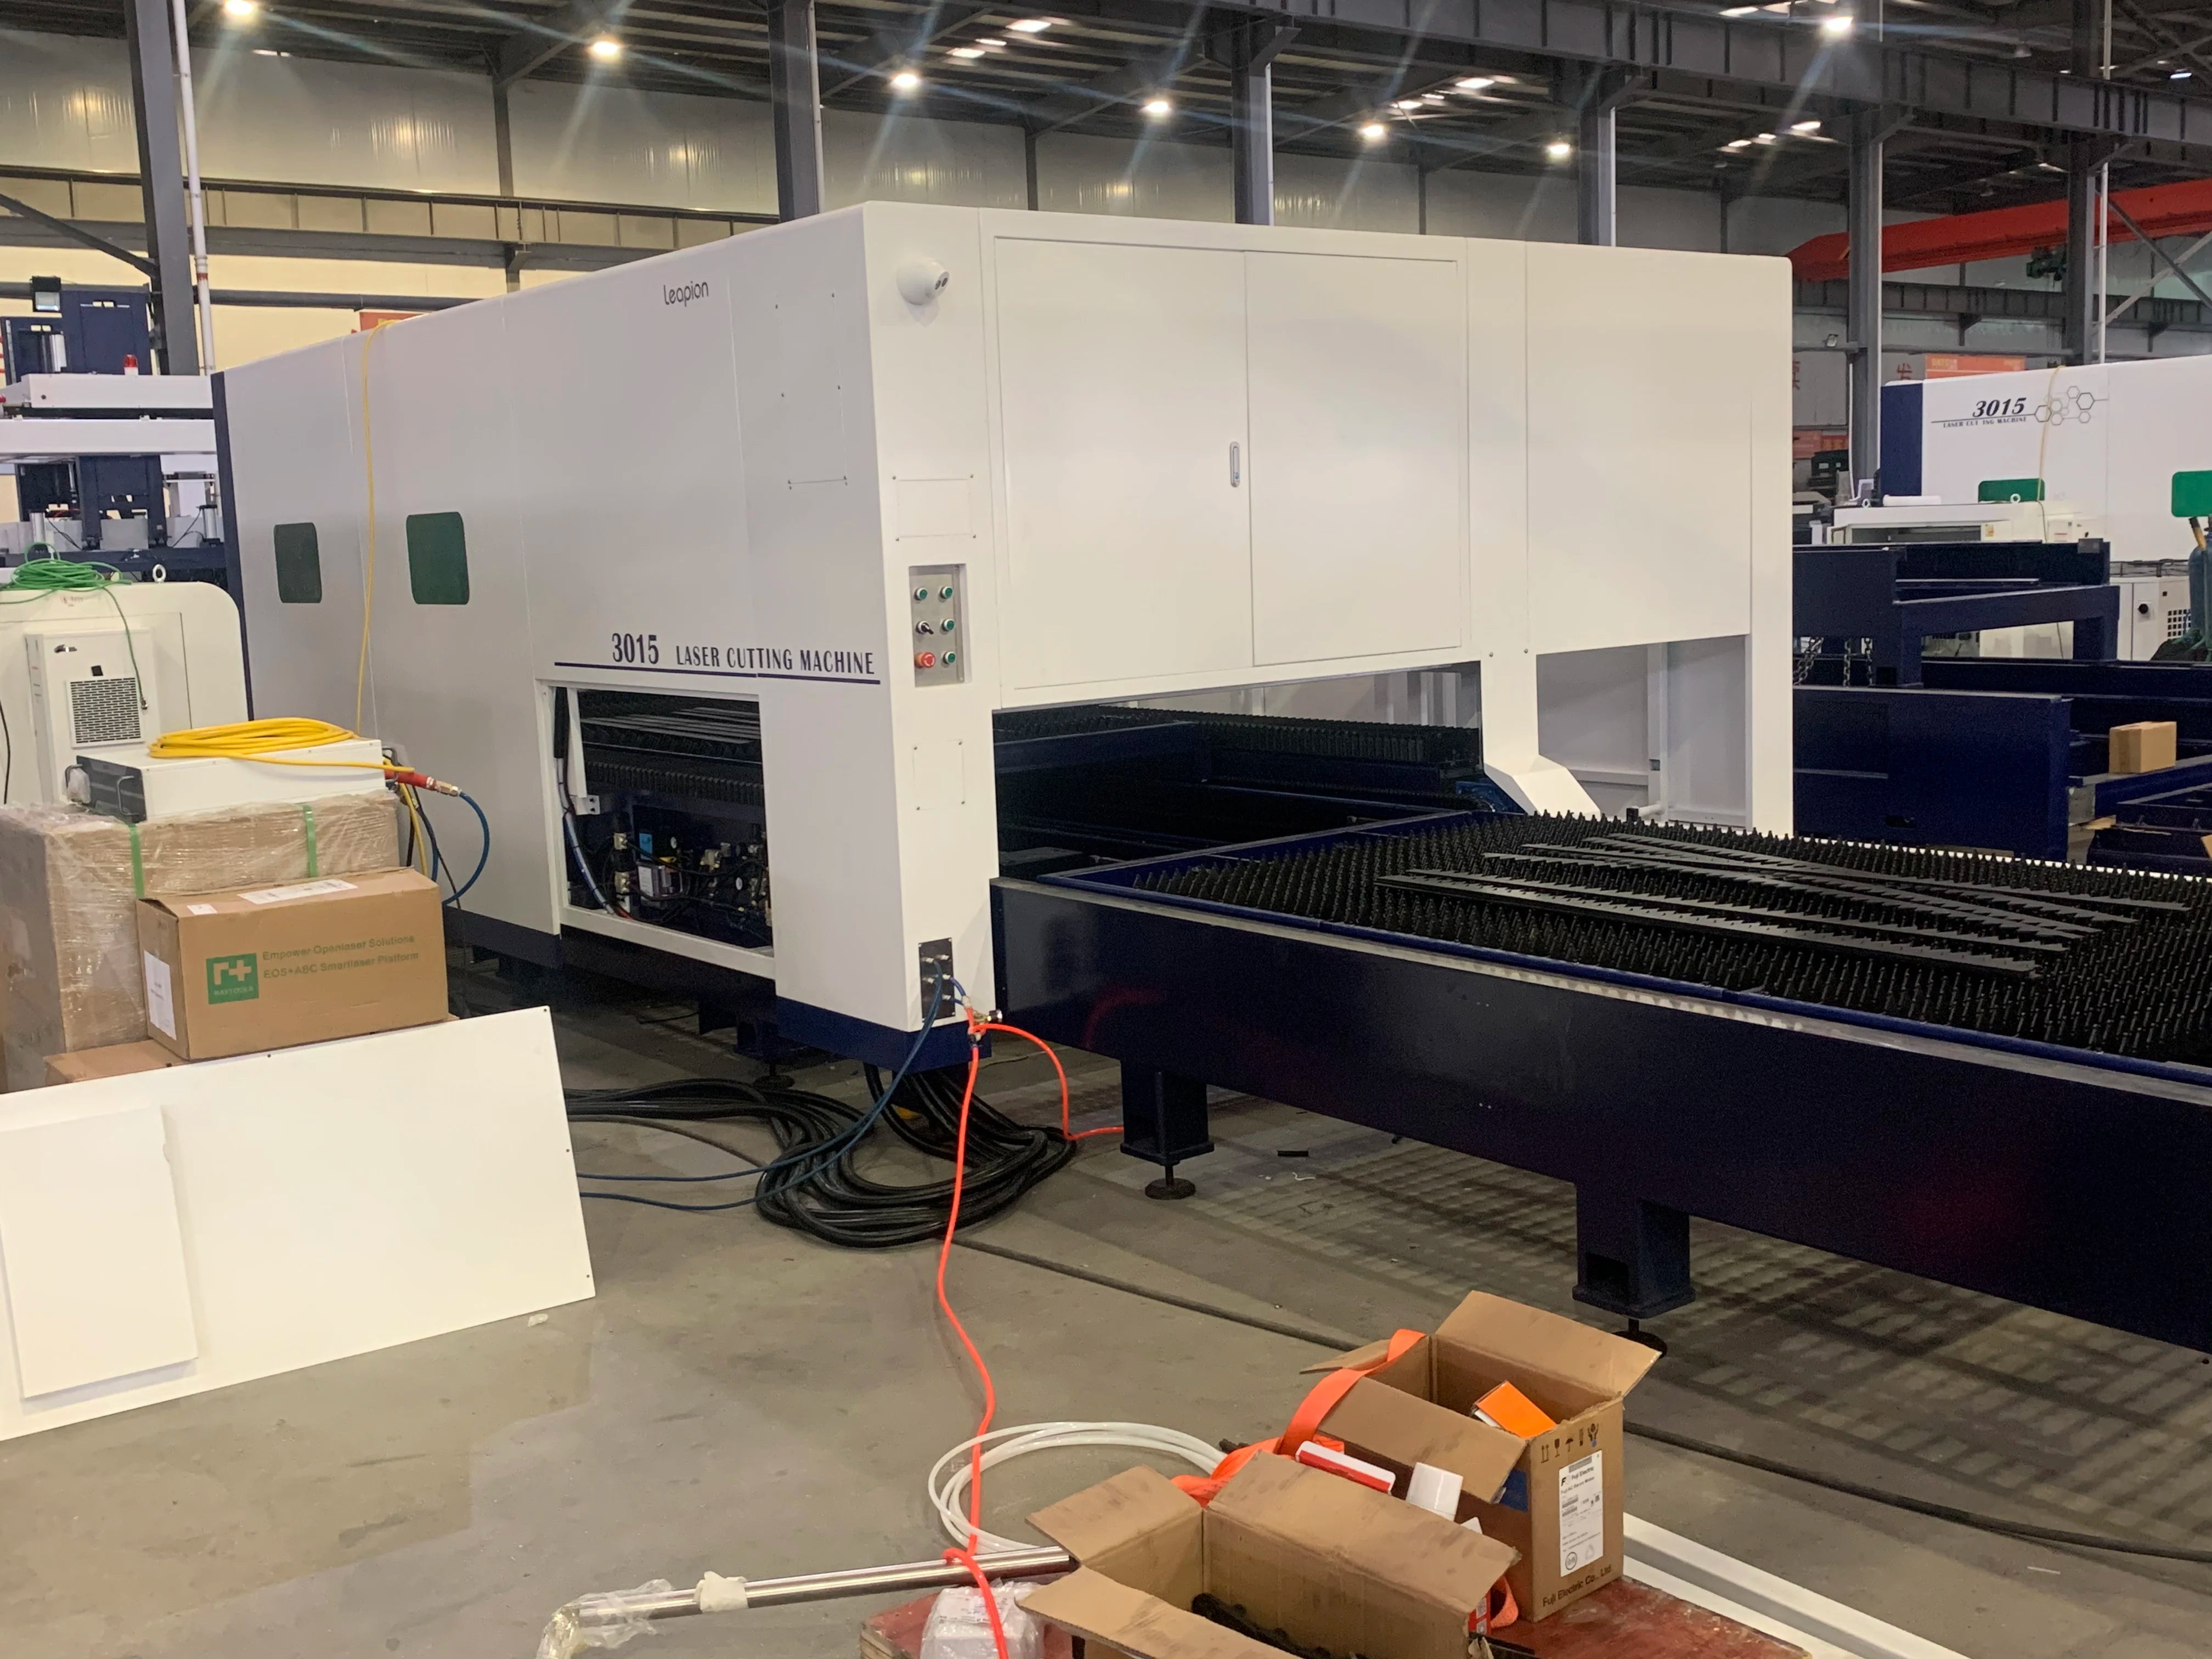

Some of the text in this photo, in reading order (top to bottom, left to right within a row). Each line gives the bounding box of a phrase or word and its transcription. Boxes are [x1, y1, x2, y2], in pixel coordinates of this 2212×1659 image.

[663, 280, 709, 307] Leapion
[1972, 397, 2027, 417] 3015
[612, 633, 659, 664] 3015
[676, 646, 875, 674] LASER CUTTING MACHINE
[262, 947, 311, 960] Empower
[369, 936, 415, 947] Solutions
[263, 952, 419, 978] EOS+ABC Smartlaser Platform
[1543, 1594, 1556, 1607] Fuji
[1558, 1580, 1584, 1600] Electric
